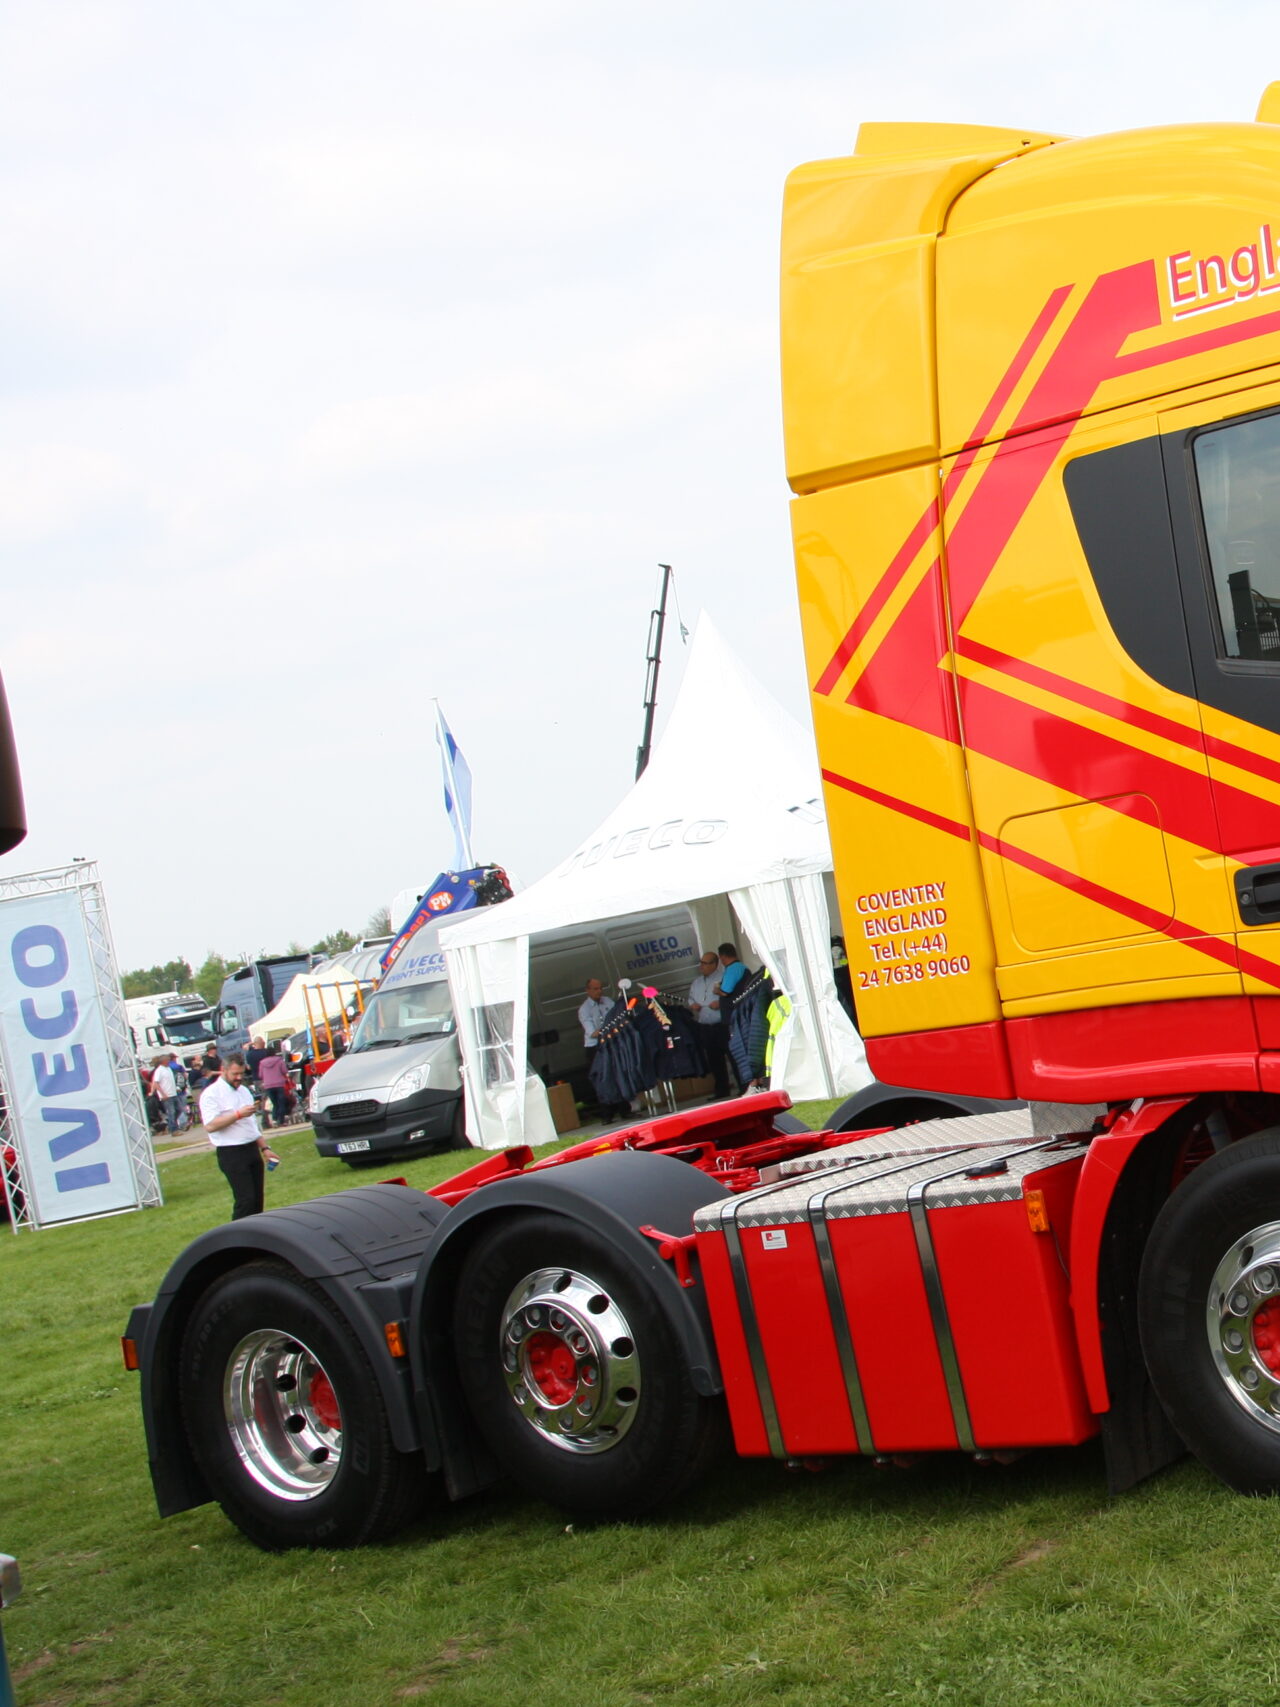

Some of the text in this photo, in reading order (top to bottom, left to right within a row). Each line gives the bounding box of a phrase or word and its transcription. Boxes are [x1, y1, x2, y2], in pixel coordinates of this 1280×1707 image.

[559, 819, 728, 878] IVECO
[856, 881, 946, 914] COVENTRY
[864, 907, 947, 938] ENGLAND
[626, 947, 693, 970] EVENT SUPPORT
[634, 935, 679, 956] IVECO
[858, 954, 970, 990] 24 7638 9060
[11, 924, 111, 1193] IVECO
